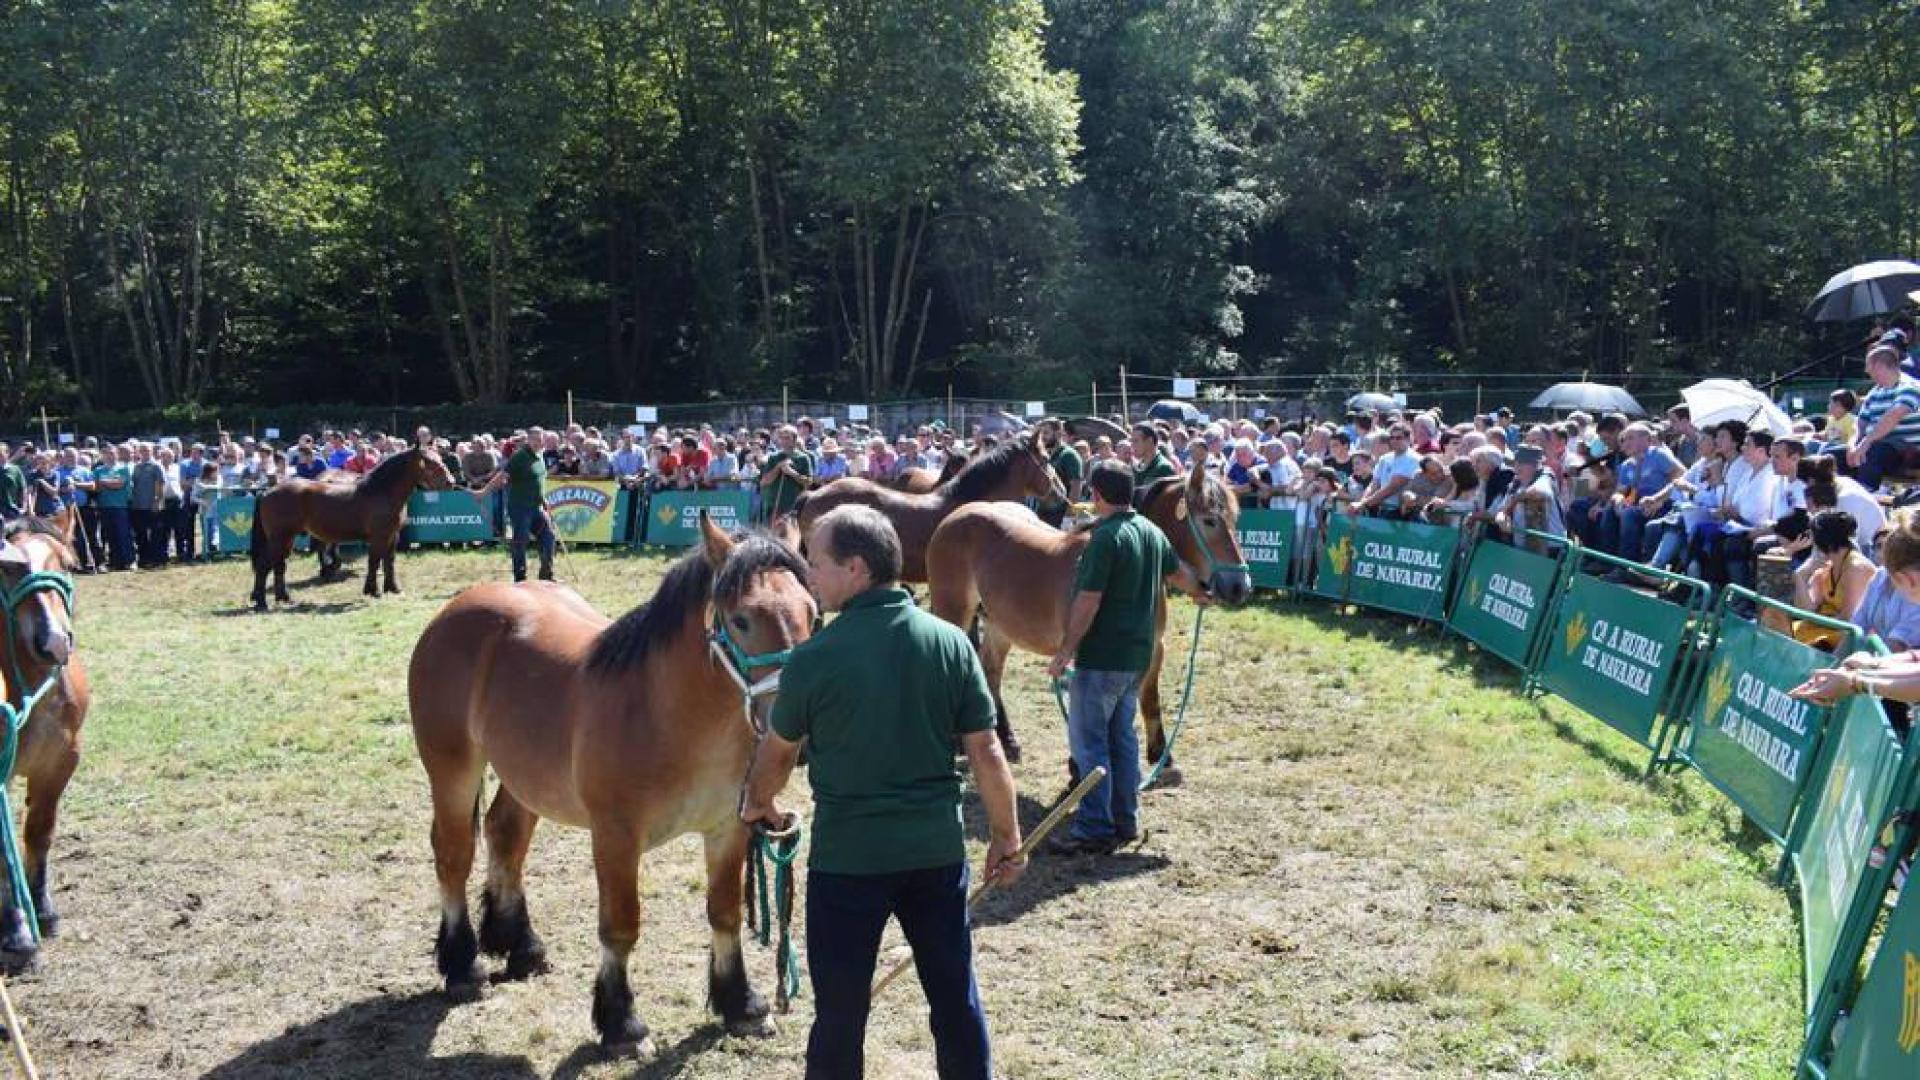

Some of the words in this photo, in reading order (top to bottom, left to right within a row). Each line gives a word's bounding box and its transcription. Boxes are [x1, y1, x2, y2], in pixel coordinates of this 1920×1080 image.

[1355, 561, 1374, 578] DE
[1365, 542, 1393, 560] CAJA
[1396, 547, 1442, 569] RURAL
[1618, 629, 1664, 667] RURAL
[1582, 645, 1600, 668] DE
[1597, 652, 1653, 696] NAVARRA
[1737, 671, 1765, 709] CAJA
[1762, 686, 1809, 736] RURAL
[1721, 706, 1741, 738] DE
[1738, 716, 1800, 782] NAVARRA
